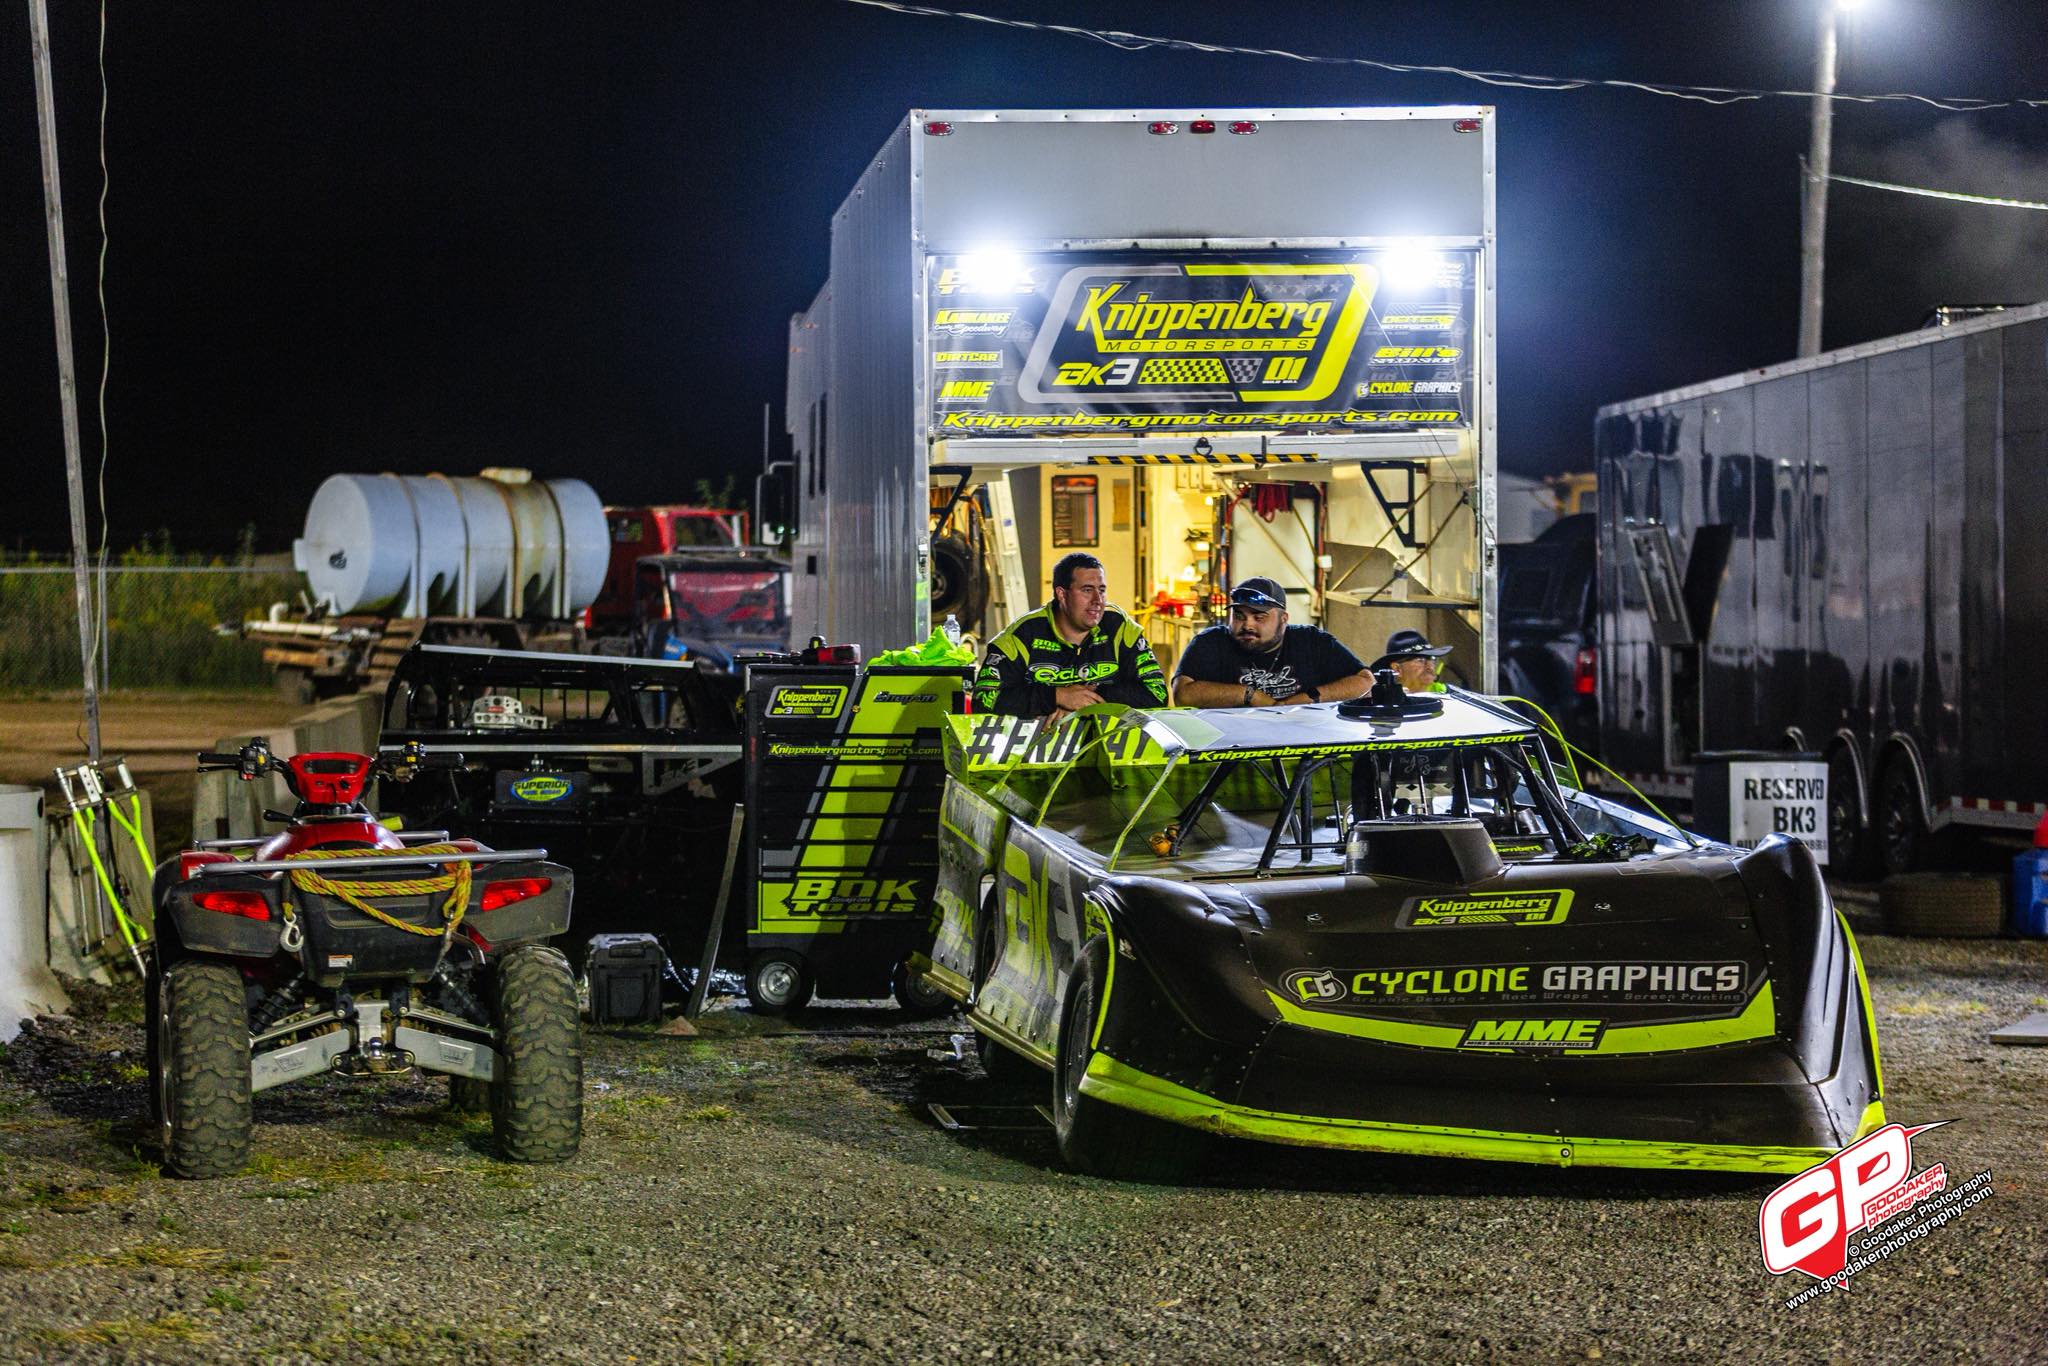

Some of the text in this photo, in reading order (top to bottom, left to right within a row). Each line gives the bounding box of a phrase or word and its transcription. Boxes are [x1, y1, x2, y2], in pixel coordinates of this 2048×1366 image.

[1075, 283, 1332, 341] Knippenberg
[1104, 340, 1309, 351] MOTORSPORTS
[1374, 347, 1459, 358] Bill's
[1052, 359, 1139, 386] BK3
[1264, 357, 1308, 381] 01
[940, 381, 994, 397] MME
[1370, 383, 1413, 393] CYCLONE
[1413, 382, 1463, 393] GRAPHICS
[943, 411, 1460, 429] Knippenbergmotorsports.com
[777, 690, 837, 703] Knippenberg
[771, 744, 941, 757] Knippenbergmotorsports.com
[1198, 734, 1526, 761] Knippenbergmotorsports.com
[514, 780, 570, 789] SUPERIOR
[1744, 778, 1824, 800] RESERVED
[1773, 806, 1816, 833] BK3
[791, 901, 916, 912] Tools
[1419, 898, 1552, 914] Knippenberg
[1412, 917, 1457, 926] BK3
[1352, 967, 1529, 994] CYCLONE
[1542, 966, 1739, 992] GRAPHICS
[1468, 1020, 1602, 1041] MME
